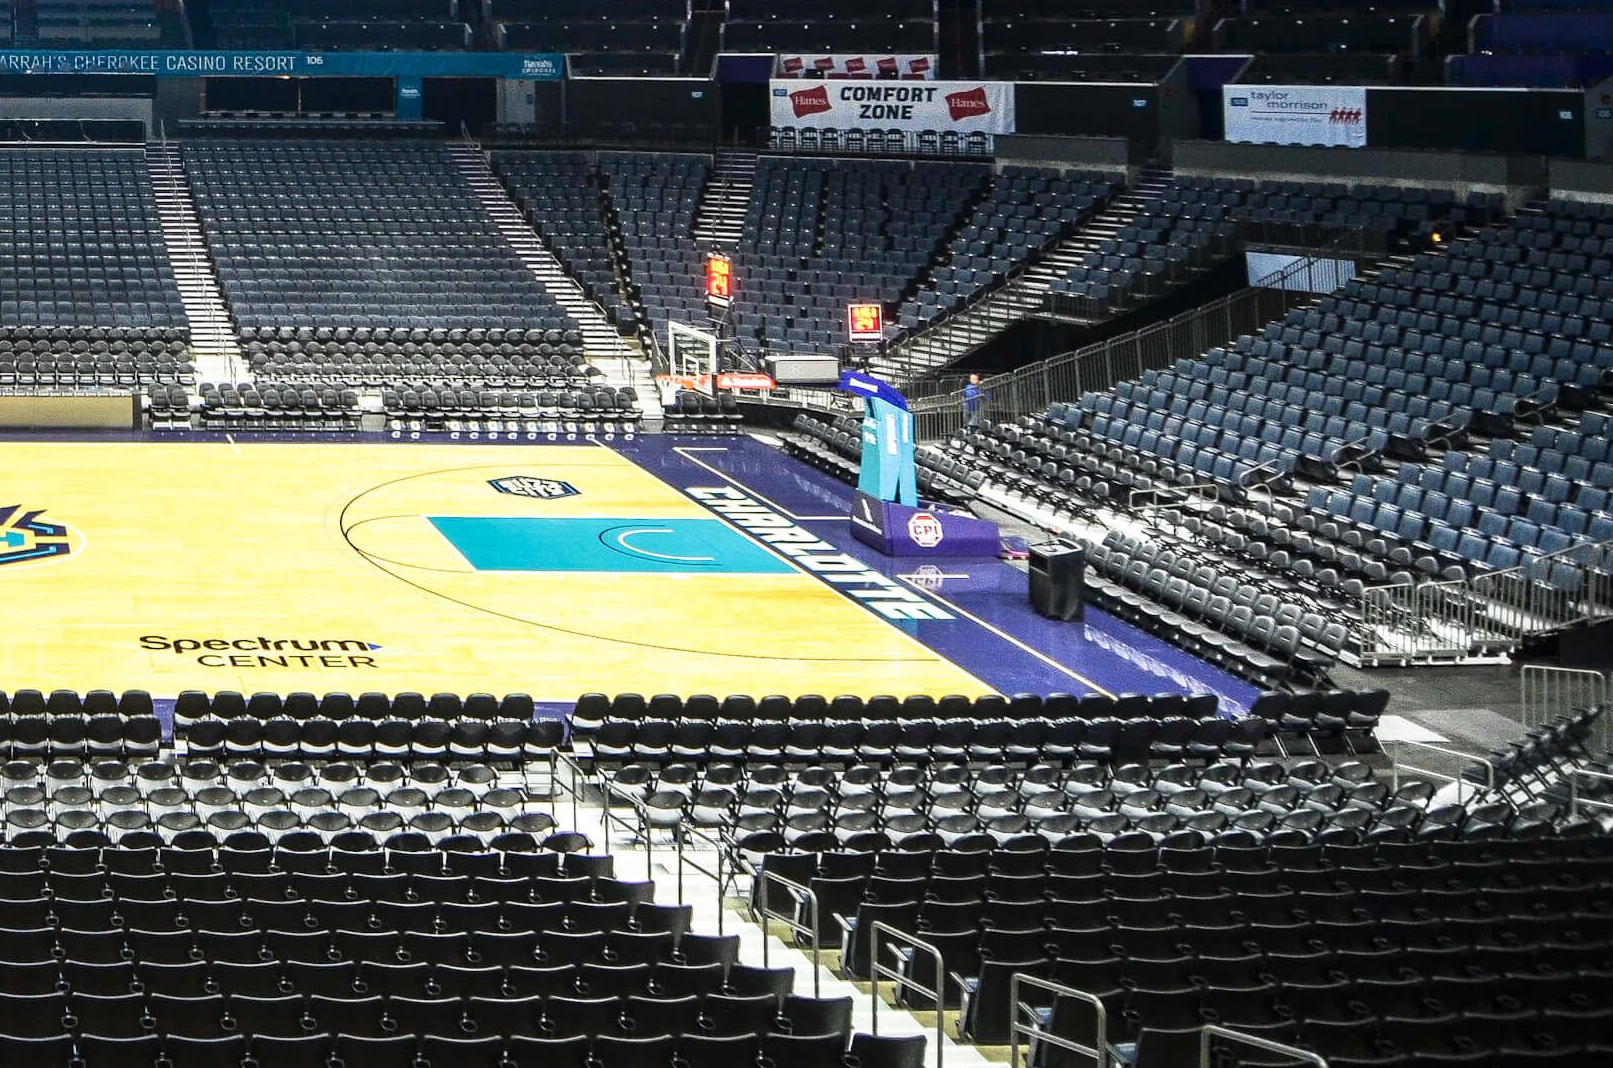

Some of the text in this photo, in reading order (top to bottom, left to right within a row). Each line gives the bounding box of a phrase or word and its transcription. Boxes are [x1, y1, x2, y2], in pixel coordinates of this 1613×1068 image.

[74, 55, 160, 70] CHEROKEE
[166, 55, 226, 70] CASINO
[233, 55, 296, 71] RESORT
[306, 55, 324, 65] 106
[840, 86, 937, 103] COMFORT
[1250, 91, 1289, 101] taylor
[795, 96, 827, 107] Hanes
[951, 97, 986, 109] Hanes
[1267, 100, 1328, 110] morrison
[858, 104, 914, 121] ZONE
[913, 525, 938, 536] CPI
[685, 485, 957, 620] CHARLOTTE
[139, 635, 369, 654] Spectrum
[197, 655, 379, 669] CENTER
